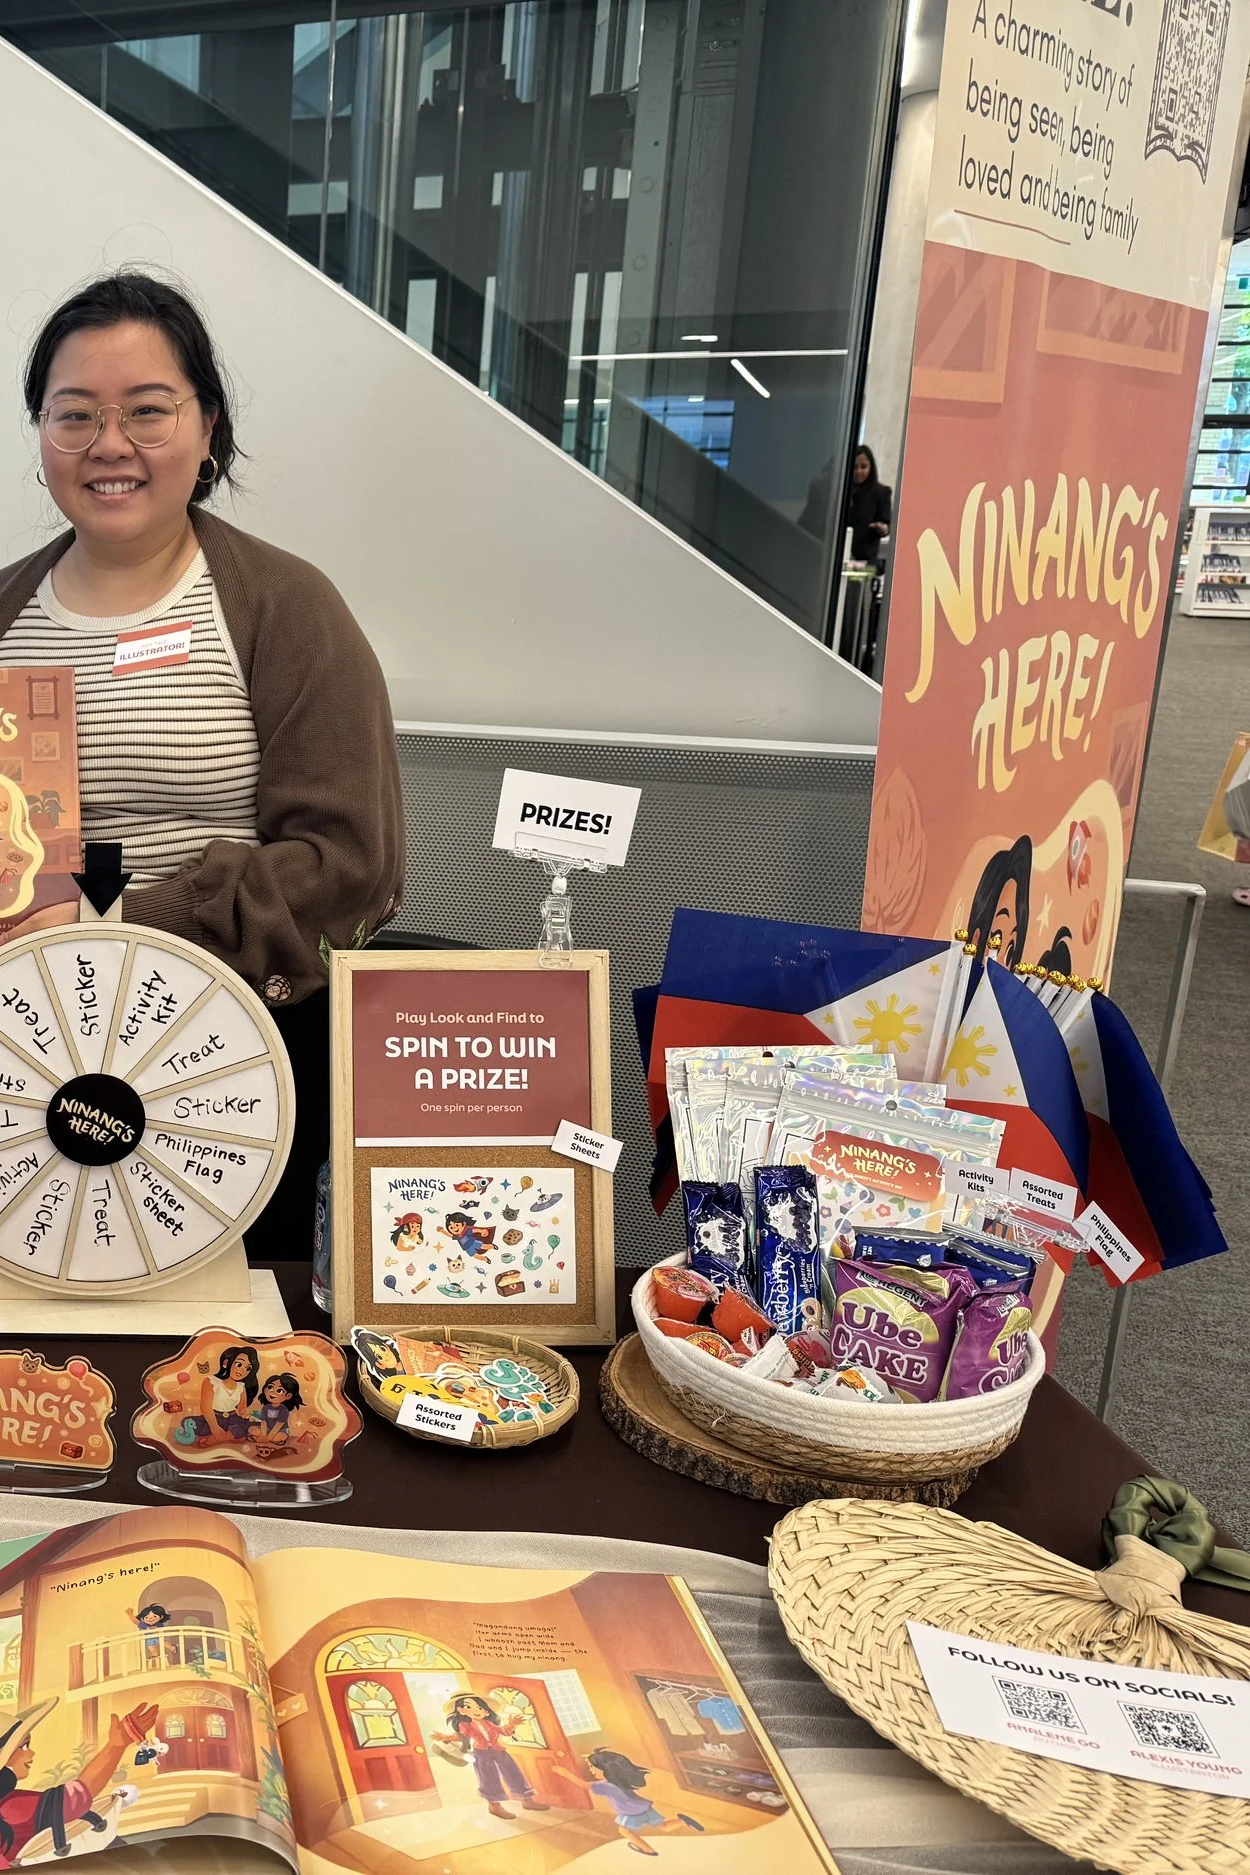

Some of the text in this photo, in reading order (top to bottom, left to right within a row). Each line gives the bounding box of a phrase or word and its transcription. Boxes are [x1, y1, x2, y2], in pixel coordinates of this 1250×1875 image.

[972, 0, 987, 39] A
[994, 0, 1075, 93] charming
[1076, 49, 1117, 111] story
[1118, 64, 1135, 108] of
[966, 58, 1114, 180] being seen, being
[958, 134, 1139, 255] loved and being family
[904, 472, 1169, 704] NINANG'S
[119, 642, 185, 661] ILLUSTRATOR!
[971, 630, 1115, 794] HERE!
[519, 802, 612, 835] PRIZES!
[75, 954, 101, 1036] Sticker
[119, 970, 166, 1046] Activity
[2, 988, 56, 1055] Treat
[396, 1012, 544, 1026] Play Look and Find to
[162, 1034, 225, 1074] Treat
[385, 1036, 557, 1058] SPIN TO WIN
[415, 1068, 528, 1090] A PRIZE!
[56, 1098, 136, 1143] NINANG'S
[174, 1095, 261, 1118] Sticker
[420, 1103, 523, 1115] One spin per person
[68, 1116, 114, 1145] HERE!
[573, 1132, 605, 1150] Sticker
[155, 1133, 247, 1166] Philippines
[570, 1142, 600, 1160] Sheets
[839, 1144, 917, 1175] NINANG'S
[183, 1159, 223, 1184] Flag
[853, 1158, 900, 1179] HERE!
[958, 1169, 994, 1185] Activity
[130, 1161, 185, 1213] Sticker
[388, 1175, 446, 1194] NINANG'S
[400, 1189, 435, 1201] HERE!
[967, 1181, 985, 1193] Kits
[1022, 1180, 1064, 1200] Assorted
[92, 1179, 116, 1247] Treat
[1026, 1193, 1056, 1210] Treats
[23, 1179, 72, 1255] Sticker
[1091, 1213, 1132, 1263] Philippines
[1095, 1234, 1114, 1258] Flag
[842, 1301, 923, 1349] Ube
[831, 1324, 929, 1385] CAKE
[415, 1403, 462, 1421] Assorted
[415, 1414, 456, 1431] Stickers
[50, 1562, 160, 1593] "Ninang's here!"
[948, 1646, 1237, 1707] FOLLOW US ON SOCIALS!
[1006, 1721, 1101, 1749] ANALENE GO
[1130, 1749, 1243, 1775] ALEXIS YOUNG
